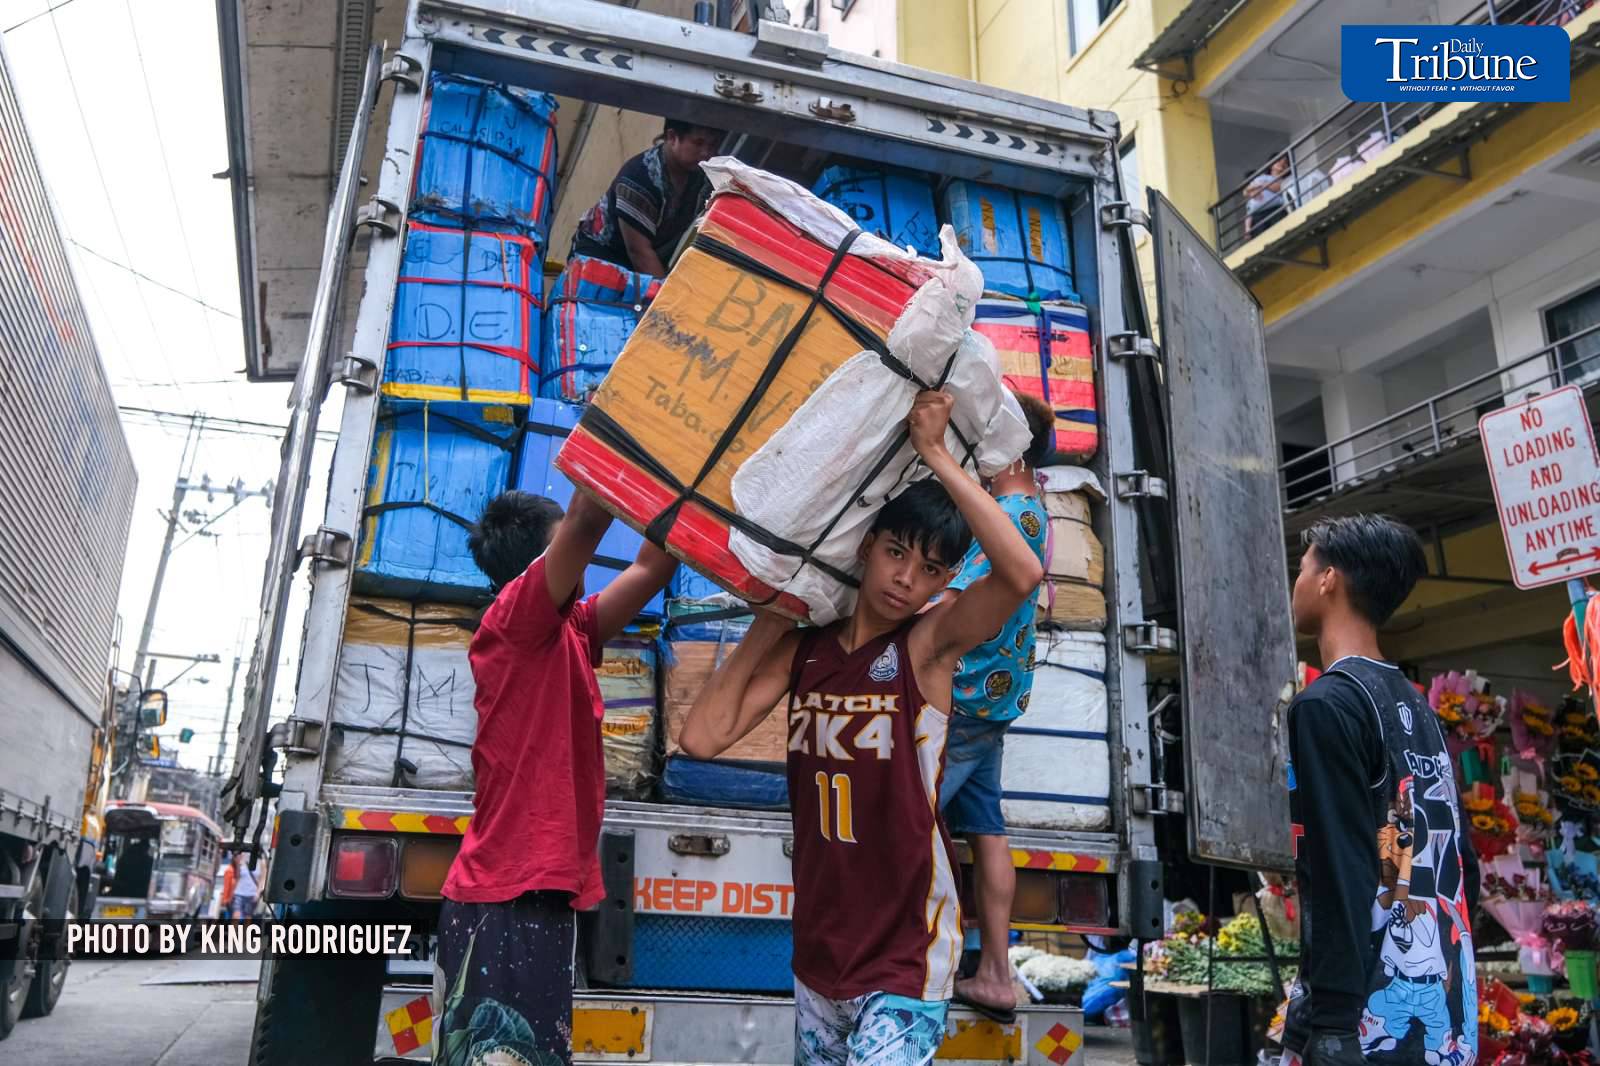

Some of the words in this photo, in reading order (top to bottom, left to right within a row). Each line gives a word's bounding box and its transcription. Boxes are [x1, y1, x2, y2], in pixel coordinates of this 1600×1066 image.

[1519, 407, 1544, 433] NO
[1503, 426, 1576, 467] LOADING
[1530, 462, 1563, 490] AND
[1505, 482, 1600, 527] UNLOADING
[1525, 515, 1598, 553] ANYTIME
[788, 709, 895, 760] 2K4
[815, 770, 858, 843] 11
[633, 877, 718, 912] KEEP
[721, 881, 794, 915] DIST
